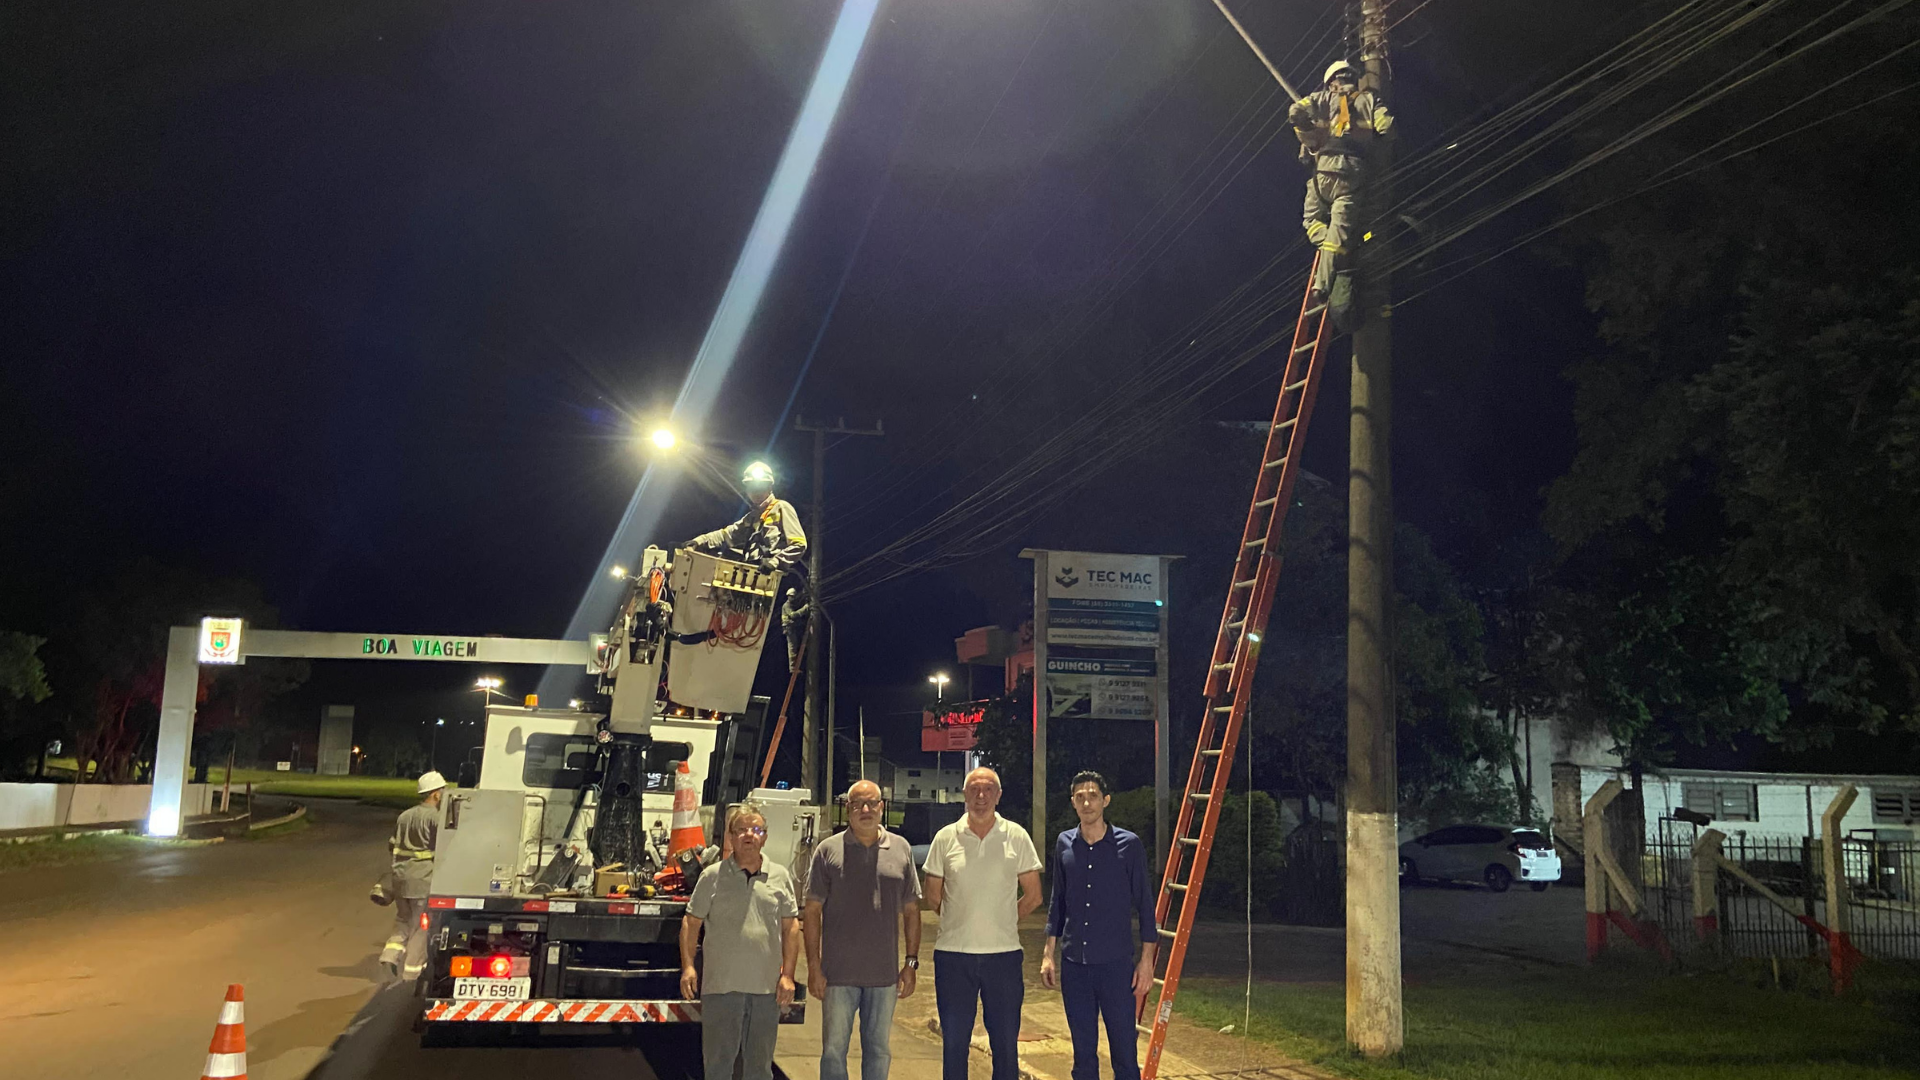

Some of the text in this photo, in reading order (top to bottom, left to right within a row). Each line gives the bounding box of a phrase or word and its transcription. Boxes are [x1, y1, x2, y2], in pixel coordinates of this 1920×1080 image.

[1087, 570, 1152, 584] TEC MAC
[363, 638, 478, 657] BOA VIAGEM
[1047, 661, 1101, 672] GUINCHO
